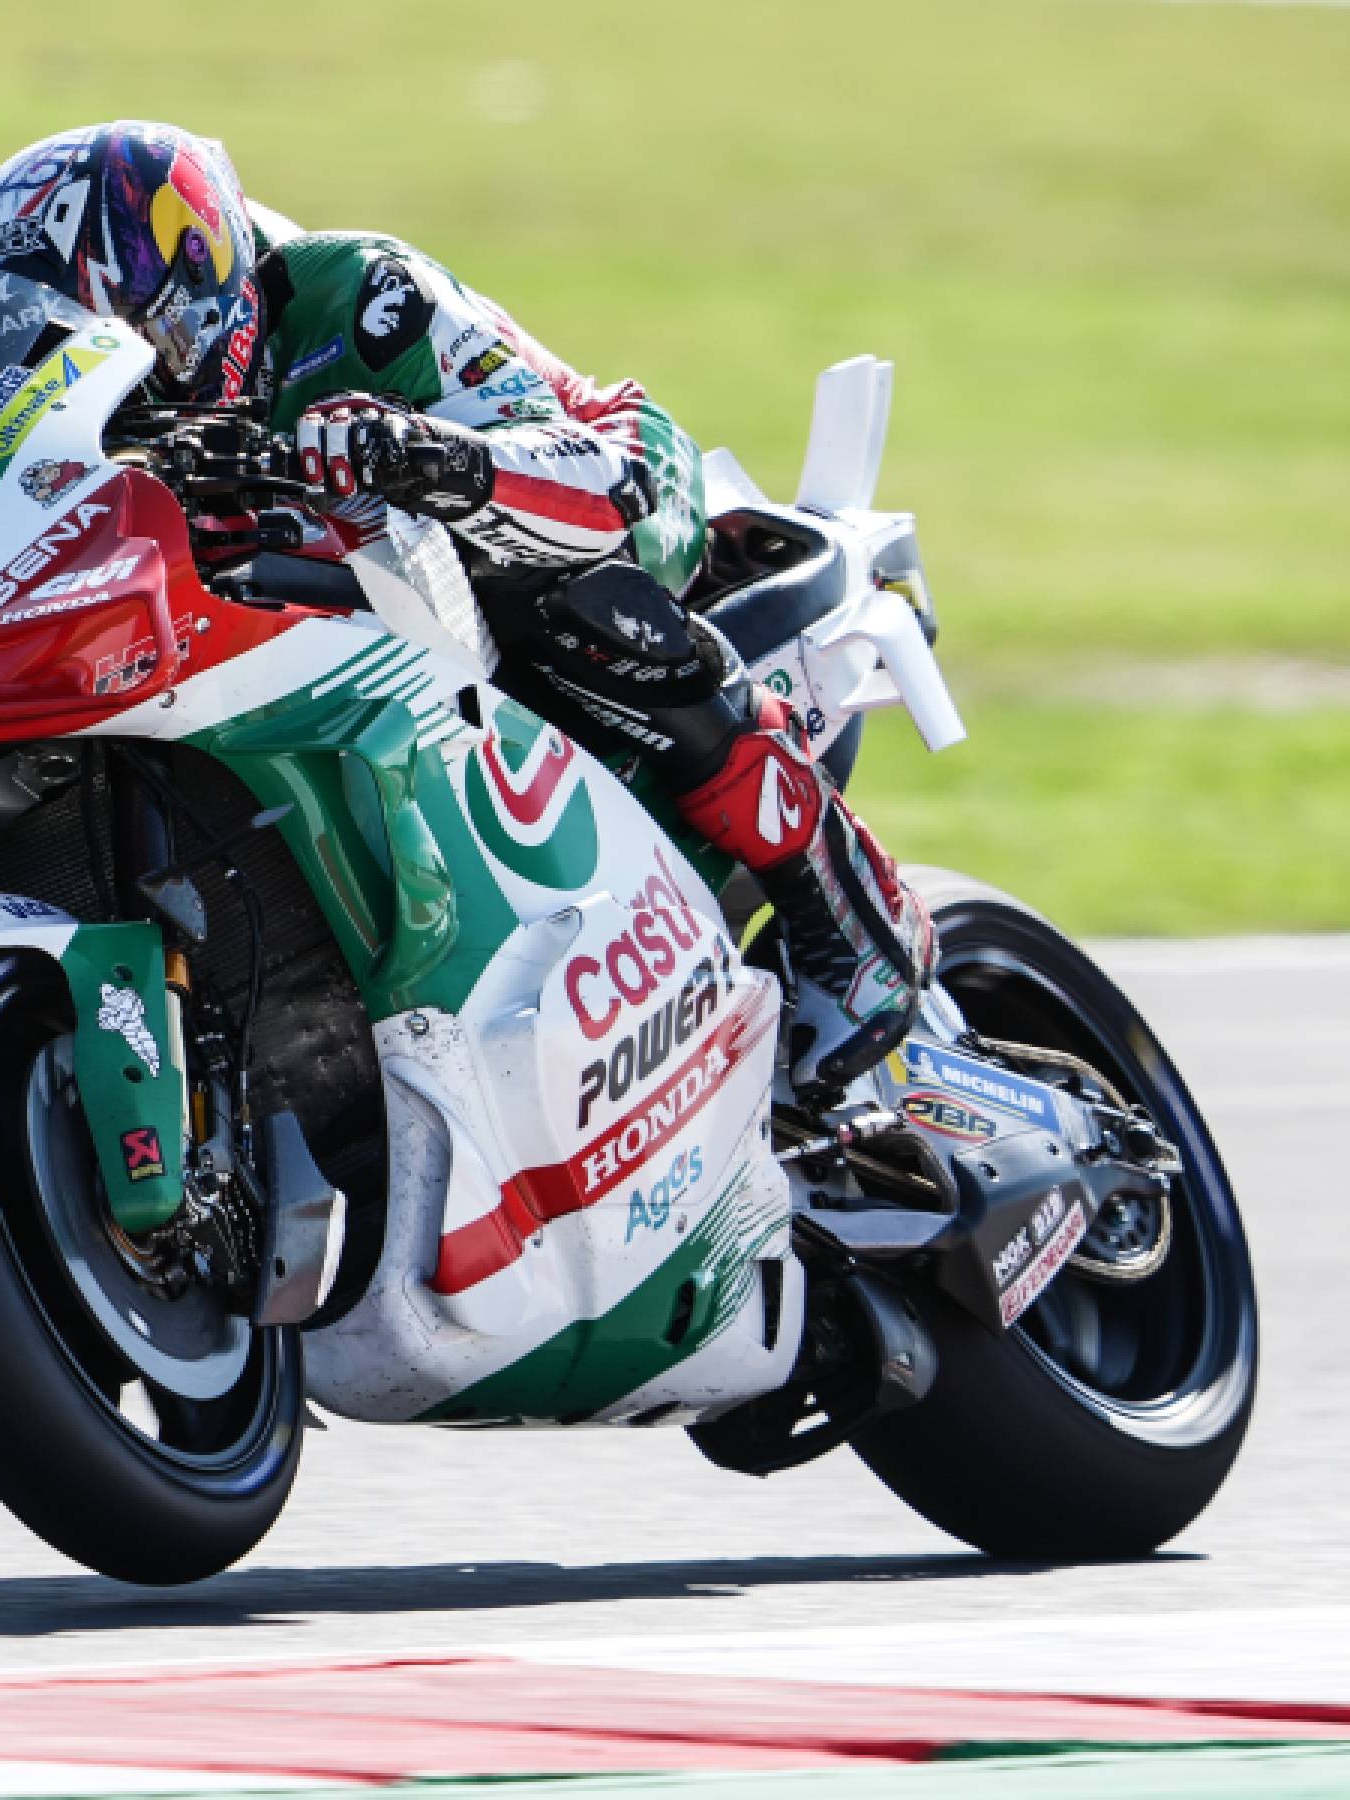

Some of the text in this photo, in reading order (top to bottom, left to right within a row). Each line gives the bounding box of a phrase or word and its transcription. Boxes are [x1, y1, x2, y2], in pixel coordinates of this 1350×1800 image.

[576, 932, 734, 1131] POWER1
[580, 1043, 728, 1195] HONDA
[900, 1097, 996, 1138] PBR
[940, 1064, 1044, 1116] MICHELIN
[623, 1145, 700, 1246] Agos
